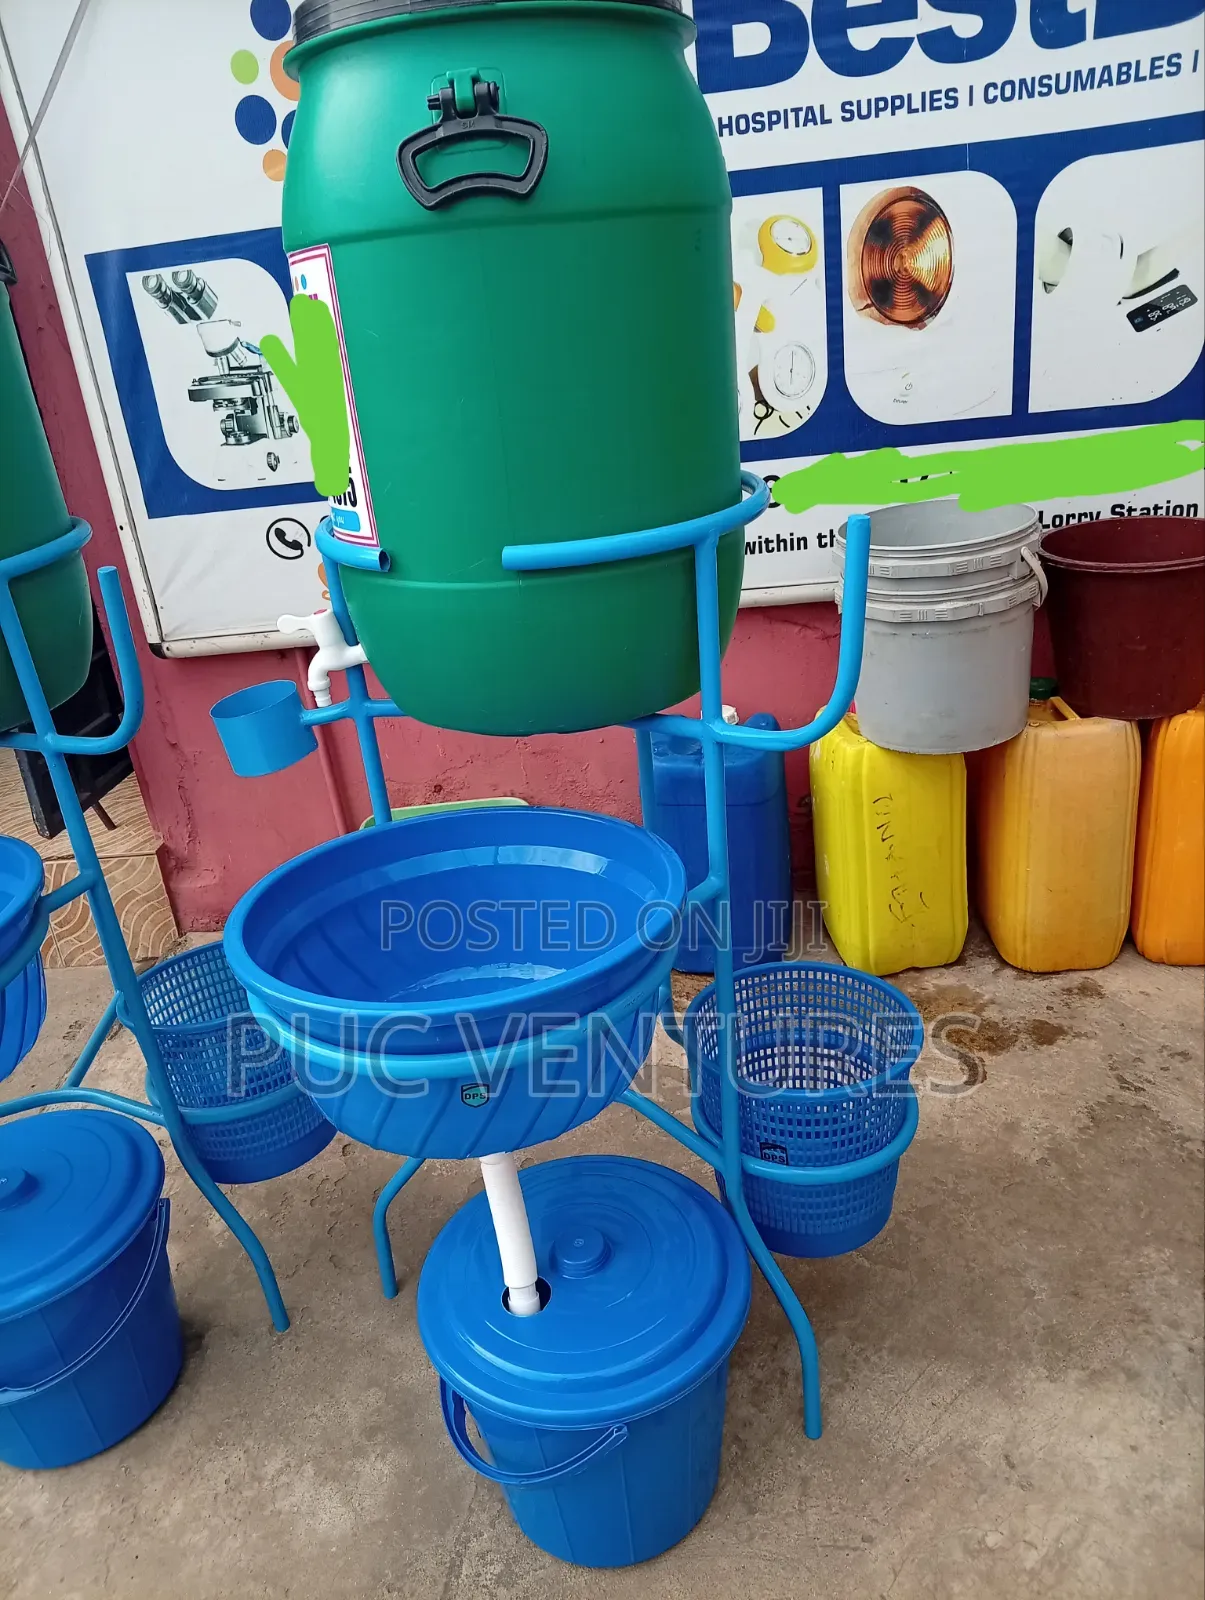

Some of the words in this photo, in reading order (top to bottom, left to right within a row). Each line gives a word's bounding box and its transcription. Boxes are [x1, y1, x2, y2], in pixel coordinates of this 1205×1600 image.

[717, 104, 833, 138] HOSPITAL
[840, 87, 959, 122] SUPPLIES
[983, 52, 1183, 105] CONSUMABLES
[744, 532, 808, 556] within
[816, 529, 837, 549] th
[1110, 499, 1199, 519] Station
[464, 1092, 487, 1100] DPS
[763, 1152, 786, 1164] DPS
